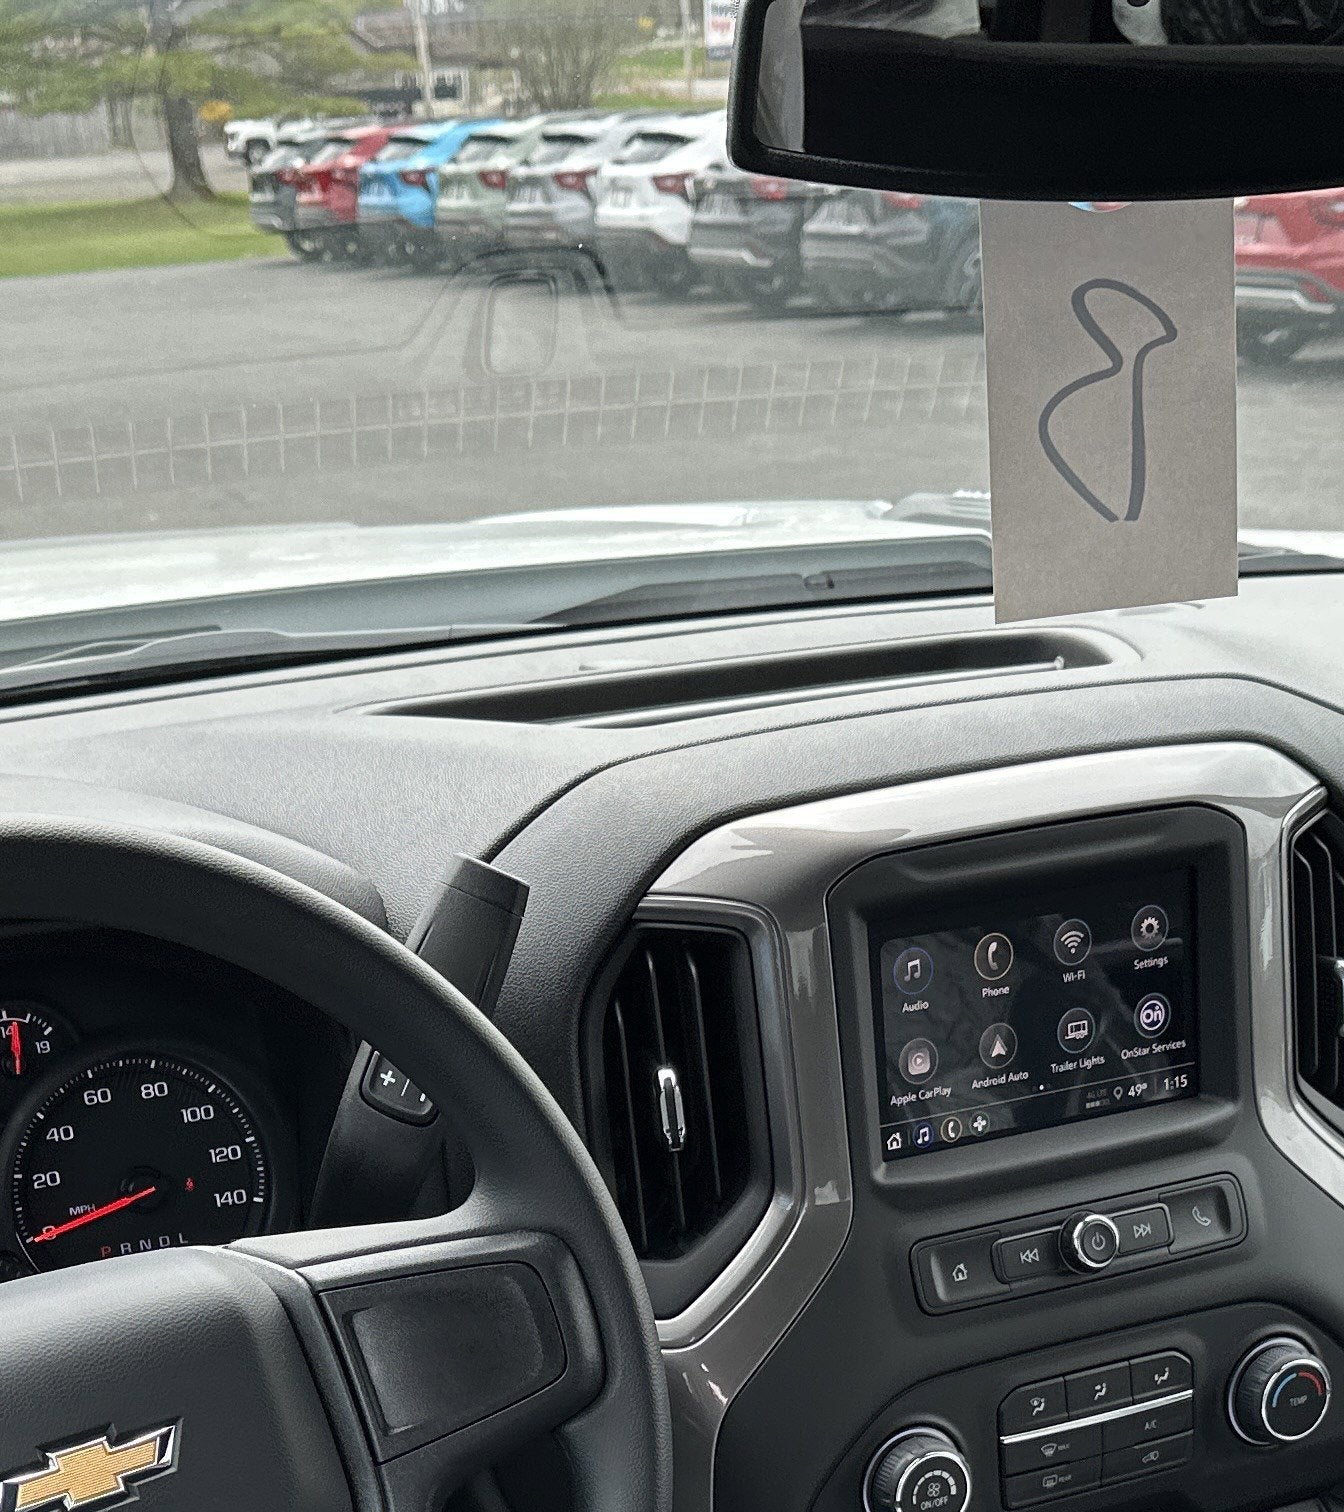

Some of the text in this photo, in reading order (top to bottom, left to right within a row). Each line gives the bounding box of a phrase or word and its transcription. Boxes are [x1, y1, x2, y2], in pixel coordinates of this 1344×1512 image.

[1038, 277, 1179, 523] 8
[1134, 955, 1168, 970] Settings
[1062, 970, 1086, 983] Wi-Fi
[982, 985, 1010, 998] Phone
[902, 1000, 929, 1013] Audio
[34, 1040, 51, 1054] 19
[1121, 1038, 1186, 1059] OnStar Services
[1051, 1054, 1105, 1074] Trailer Lights
[972, 1070, 1029, 1089] Android Auto
[1164, 1074, 1188, 1091] 1:15
[83, 1088, 112, 1106] 60
[140, 1081, 168, 1099] 80
[891, 1085, 952, 1107] Apple CarPlay
[180, 1104, 215, 1123] 100
[46, 1125, 74, 1142] 40
[208, 1145, 242, 1163] 120
[32, 1170, 61, 1190] 20
[214, 1189, 247, 1207] 140
[69, 1203, 96, 1216] MPH
[100, 1233, 189, 1257] P R N D L
[920, 1495, 948, 1510] ON/OFF
